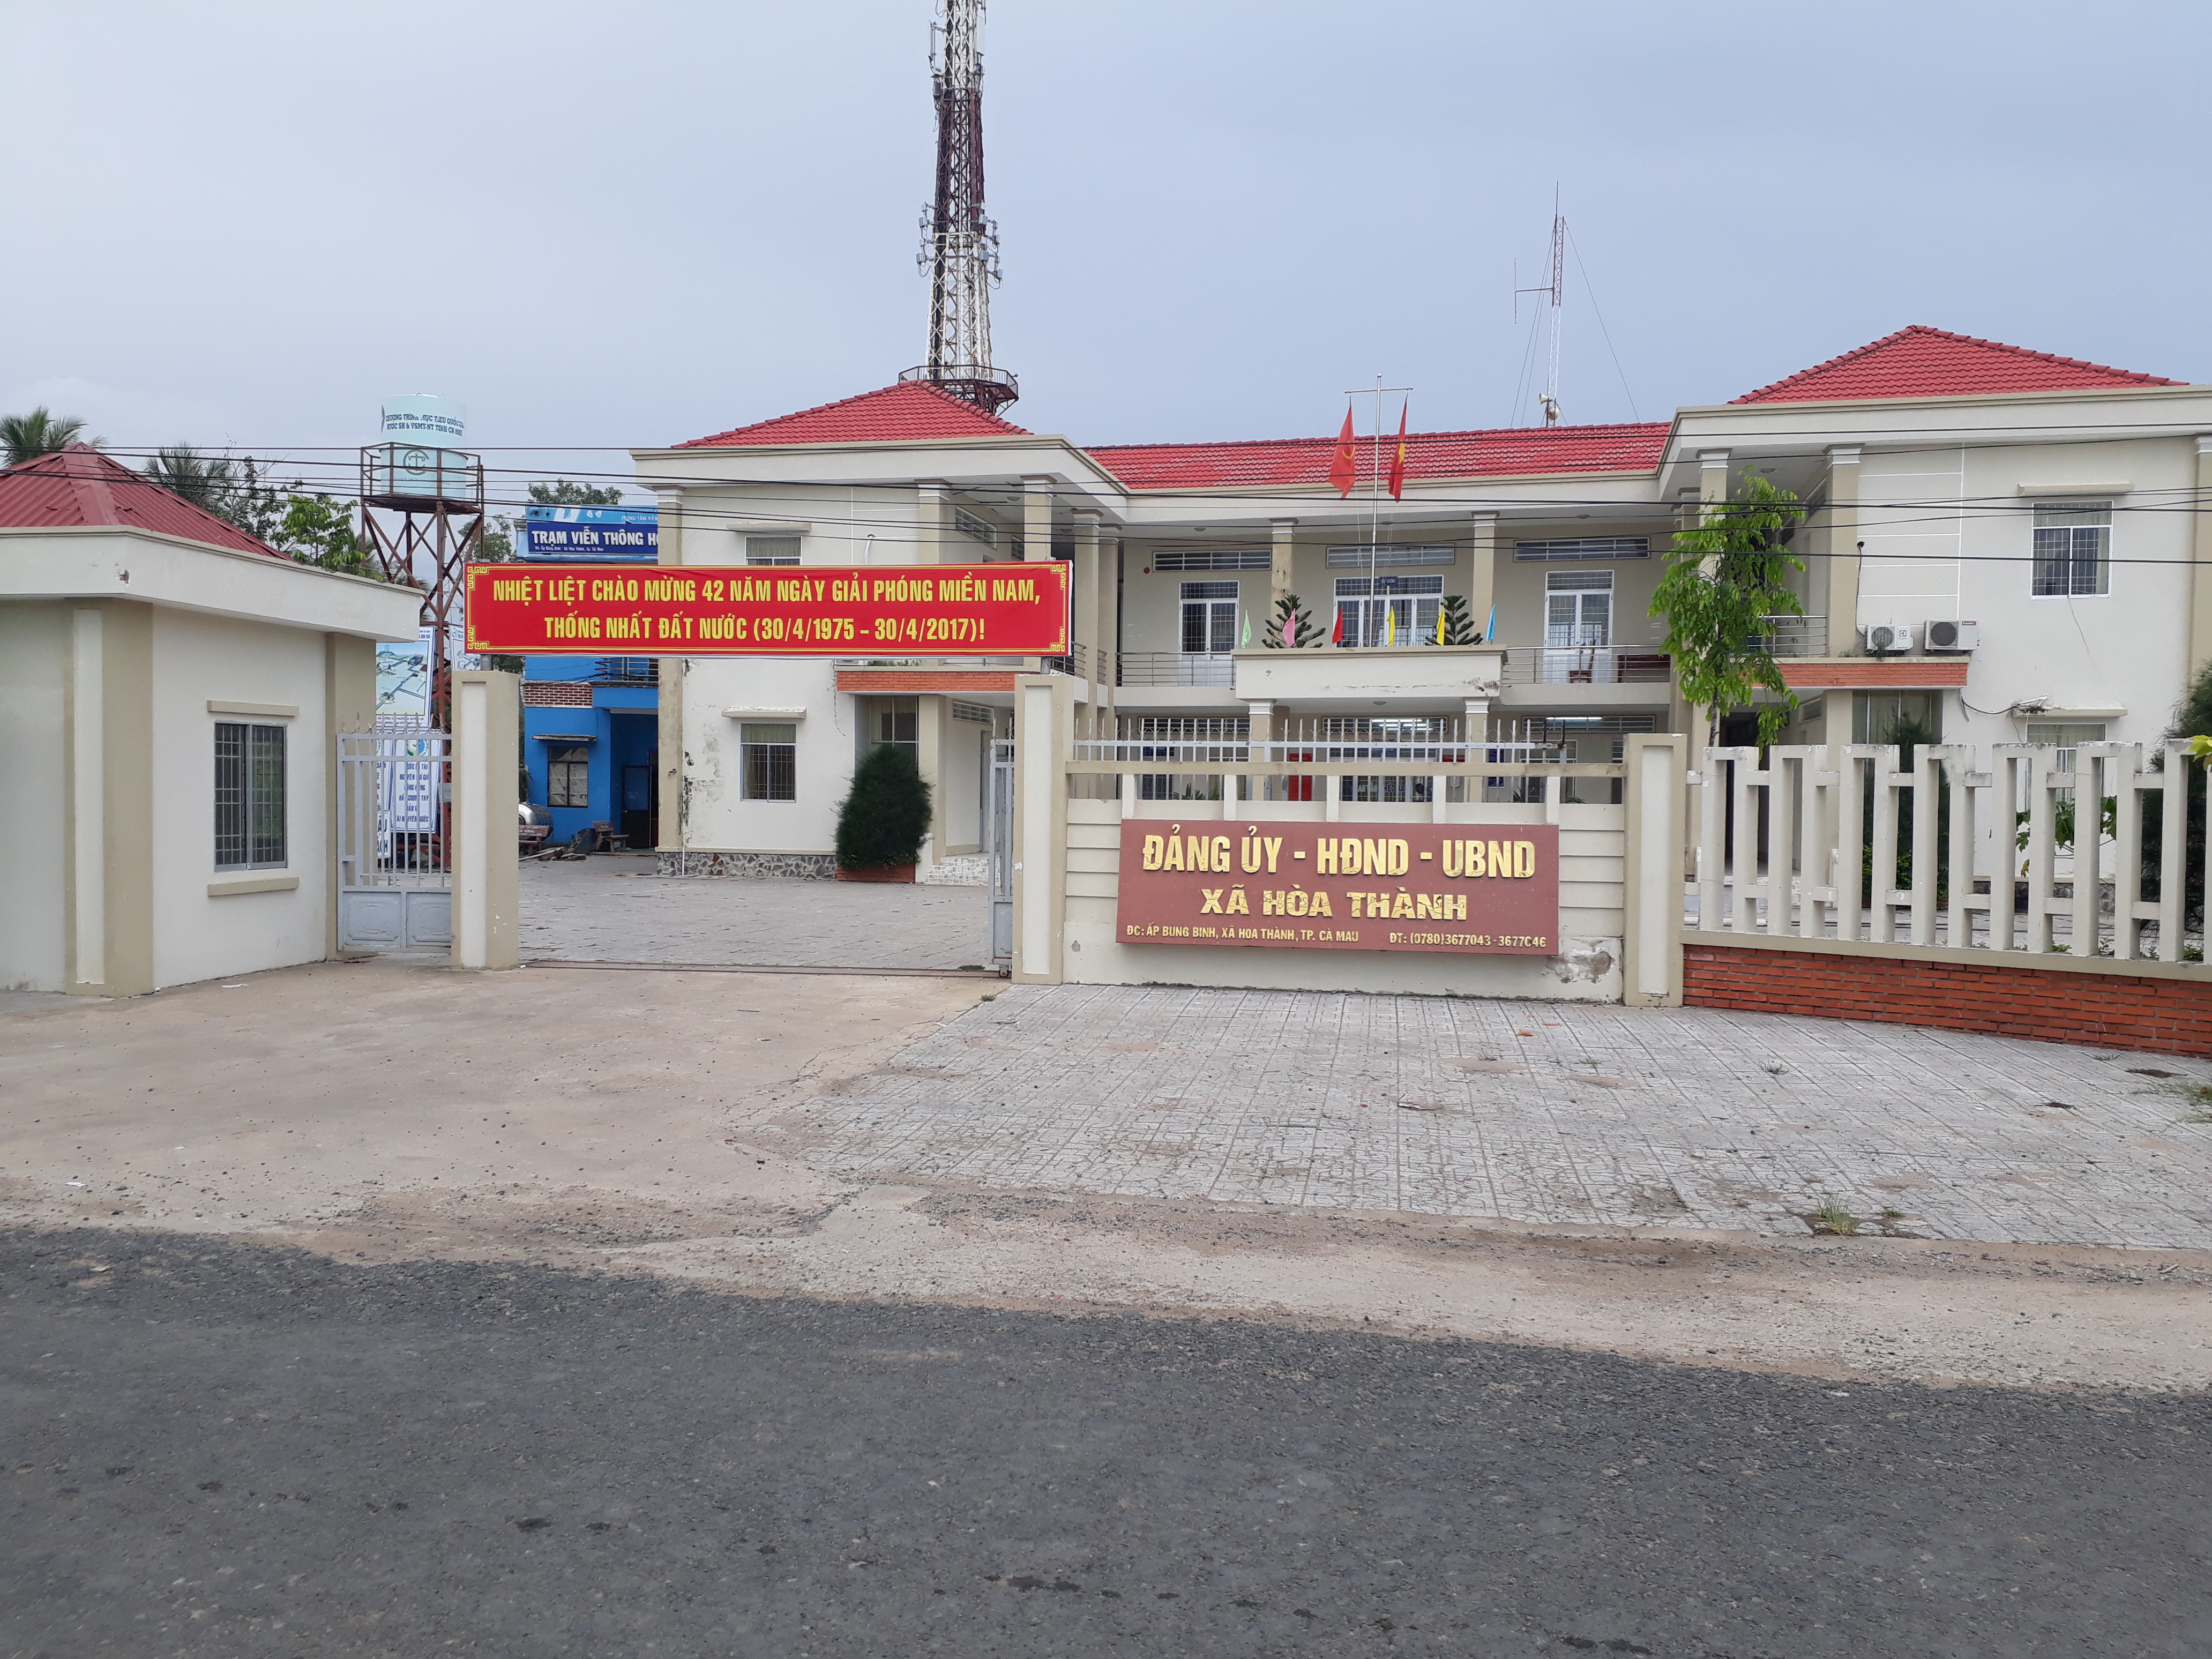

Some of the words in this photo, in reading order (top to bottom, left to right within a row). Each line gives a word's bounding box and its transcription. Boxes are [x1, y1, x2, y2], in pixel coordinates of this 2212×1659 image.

[532, 530, 567, 547] TRẠM
[571, 526, 599, 545] VIỄN
[603, 528, 644, 545] THÔNG
[648, 532, 658, 546] H
[493, 576, 543, 606] NHIỆT
[549, 576, 587, 606] LIỆT
[592, 575, 638, 601] CHÀO
[644, 575, 696, 601] MỪNG
[702, 580, 724, 601] 42
[730, 576, 771, 601] NĂM
[777, 576, 826, 602] NGÀY
[832, 572, 868, 601] GIẢI
[874, 575, 933, 601] PHÓNG
[939, 571, 987, 601] MIỀN
[993, 579, 1040, 604] NAM,
[544, 610, 600, 639] THỐNG
[606, 611, 652, 639] NHẤT
[658, 611, 693, 639] ĐẤT
[699, 613, 747, 639] NƯỚC
[753, 617, 855, 642] (30/4/1975
[875, 617, 985, 642] 30/4/2017)!
[1142, 824, 1231, 873] ĐẢNG
[1241, 825, 1283, 874] ỦY
[1317, 838, 1409, 876] HĐND
[1442, 839, 1536, 878] UBND
[1200, 884, 1250, 915] XÃ
[1262, 884, 1333, 917] HÒA
[1346, 886, 1467, 921] THÀNH
[1126, 925, 1145, 936] ĐC:
[1146, 922, 1160, 937] ẤP
[1221, 925, 1236, 939] XÃ
[1260, 926, 1299, 943] THÀNH,
[1300, 930, 1316, 941] TP.
[1319, 928, 1333, 941] CÀ
[1336, 931, 1359, 942] MAU
[1389, 932, 1408, 944] ĐT:
